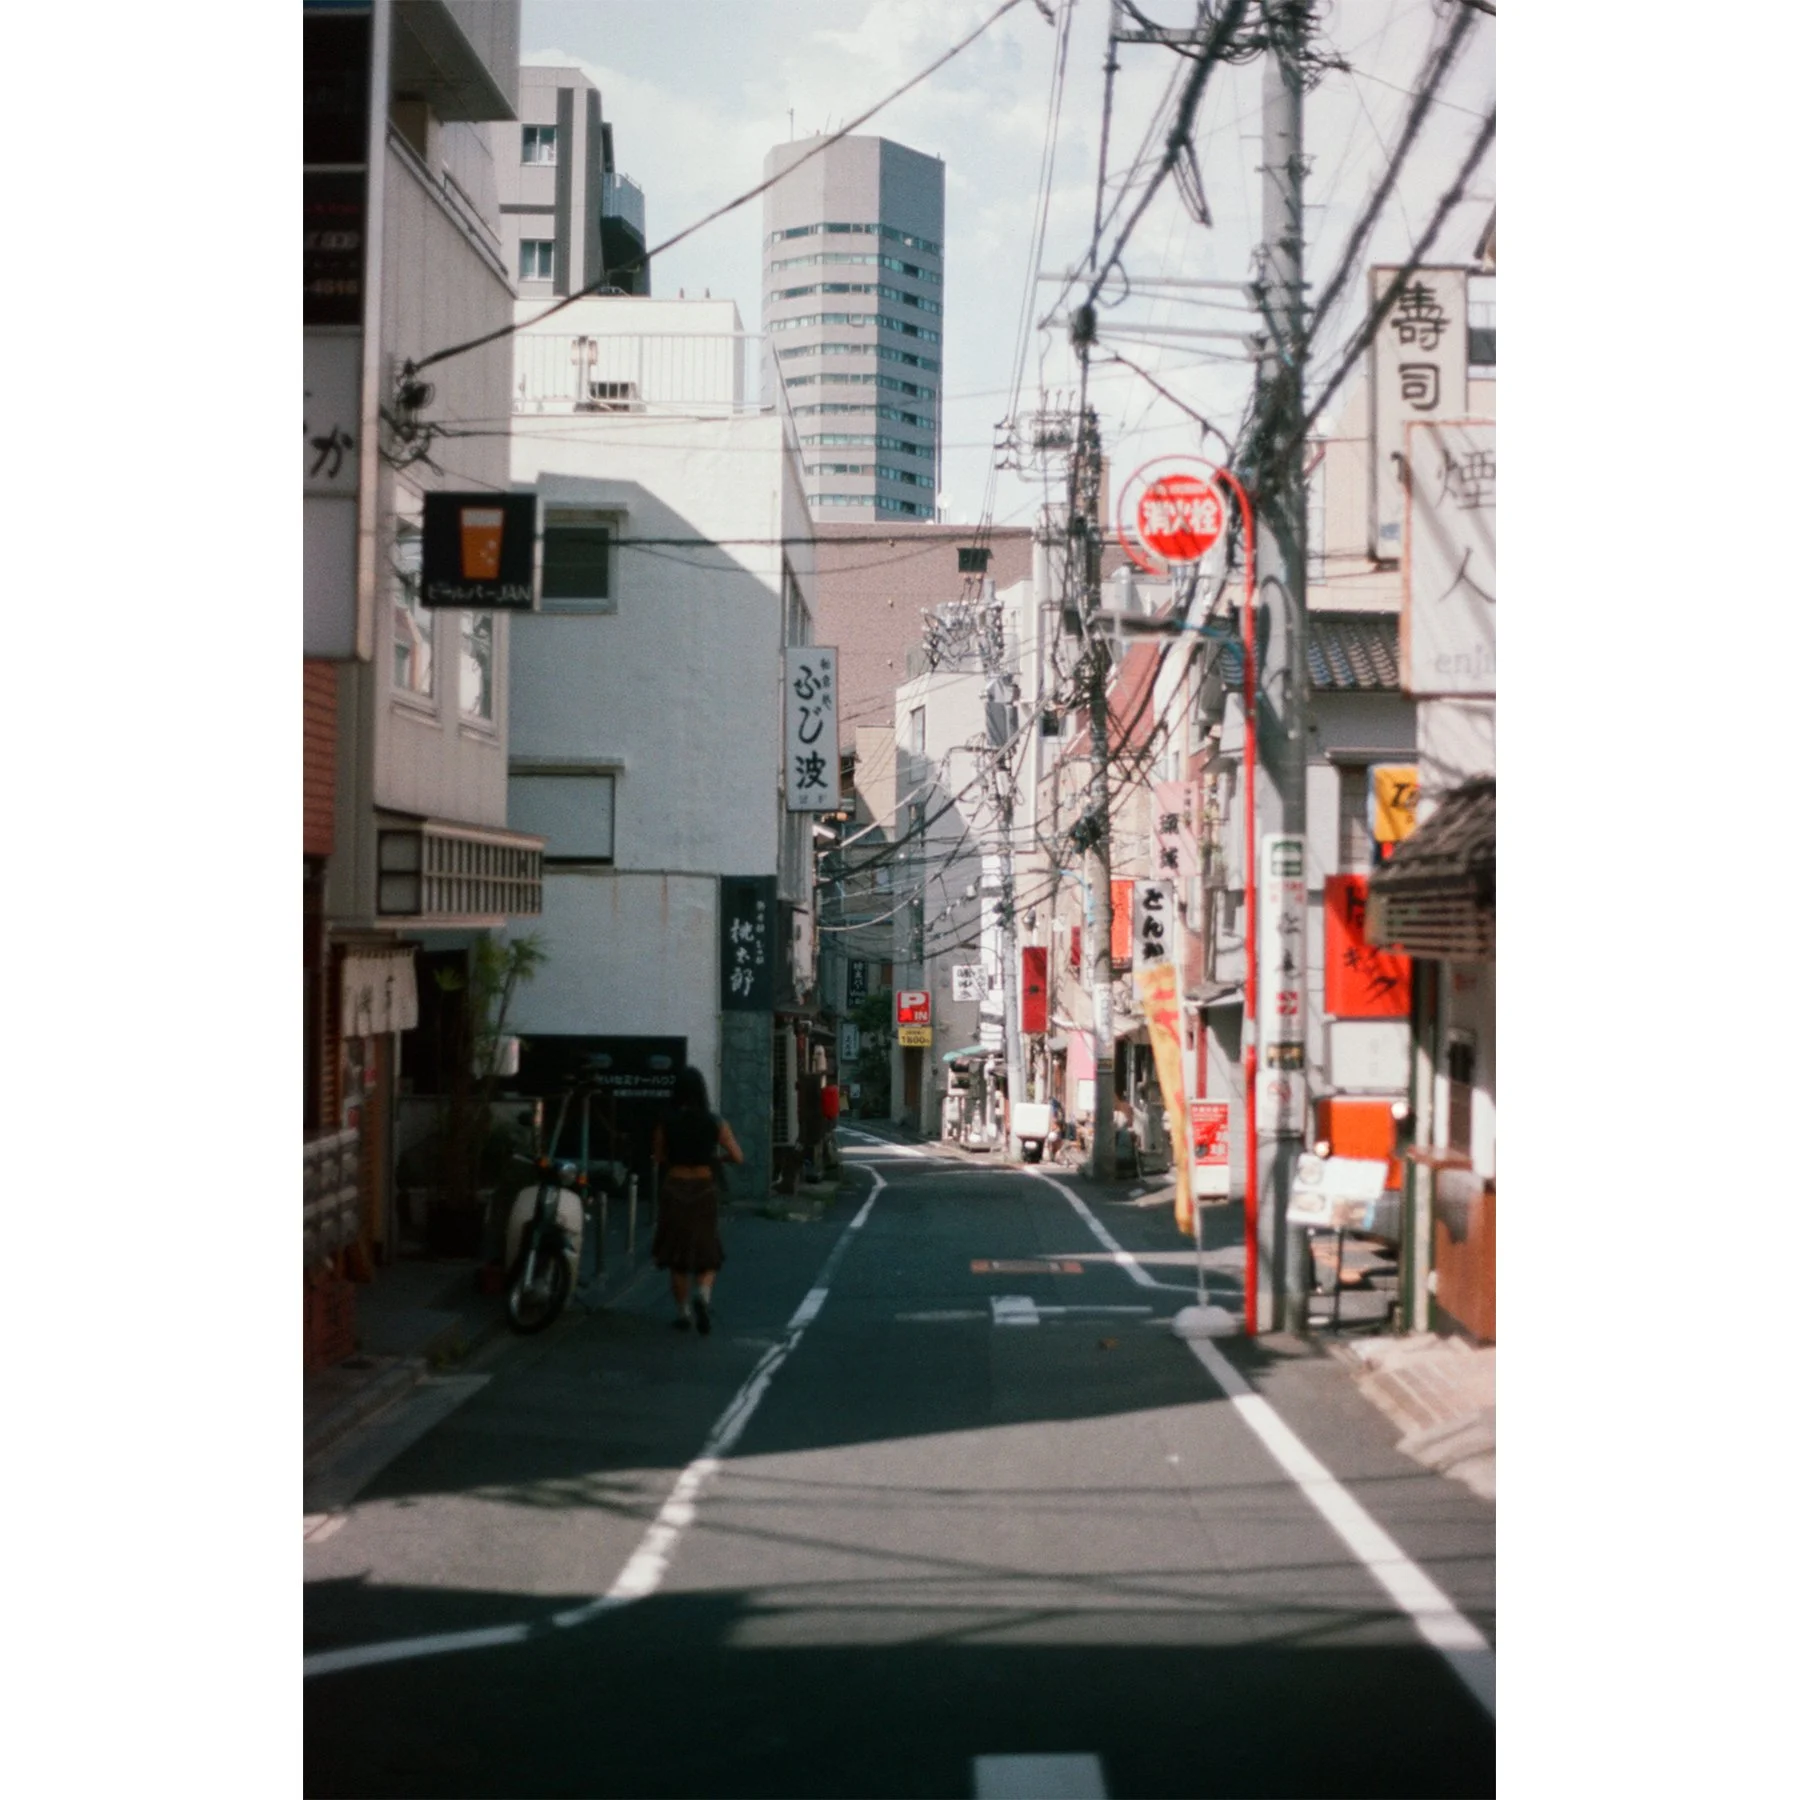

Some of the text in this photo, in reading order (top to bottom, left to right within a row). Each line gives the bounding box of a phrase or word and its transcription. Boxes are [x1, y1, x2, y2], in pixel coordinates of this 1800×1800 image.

[1142, 500, 1218, 536] 消火栓
[793, 665, 828, 788] ふじ波
[730, 917, 755, 997] 桃太郎
[900, 991, 926, 1009] P
[914, 1010, 928, 1021] IN
